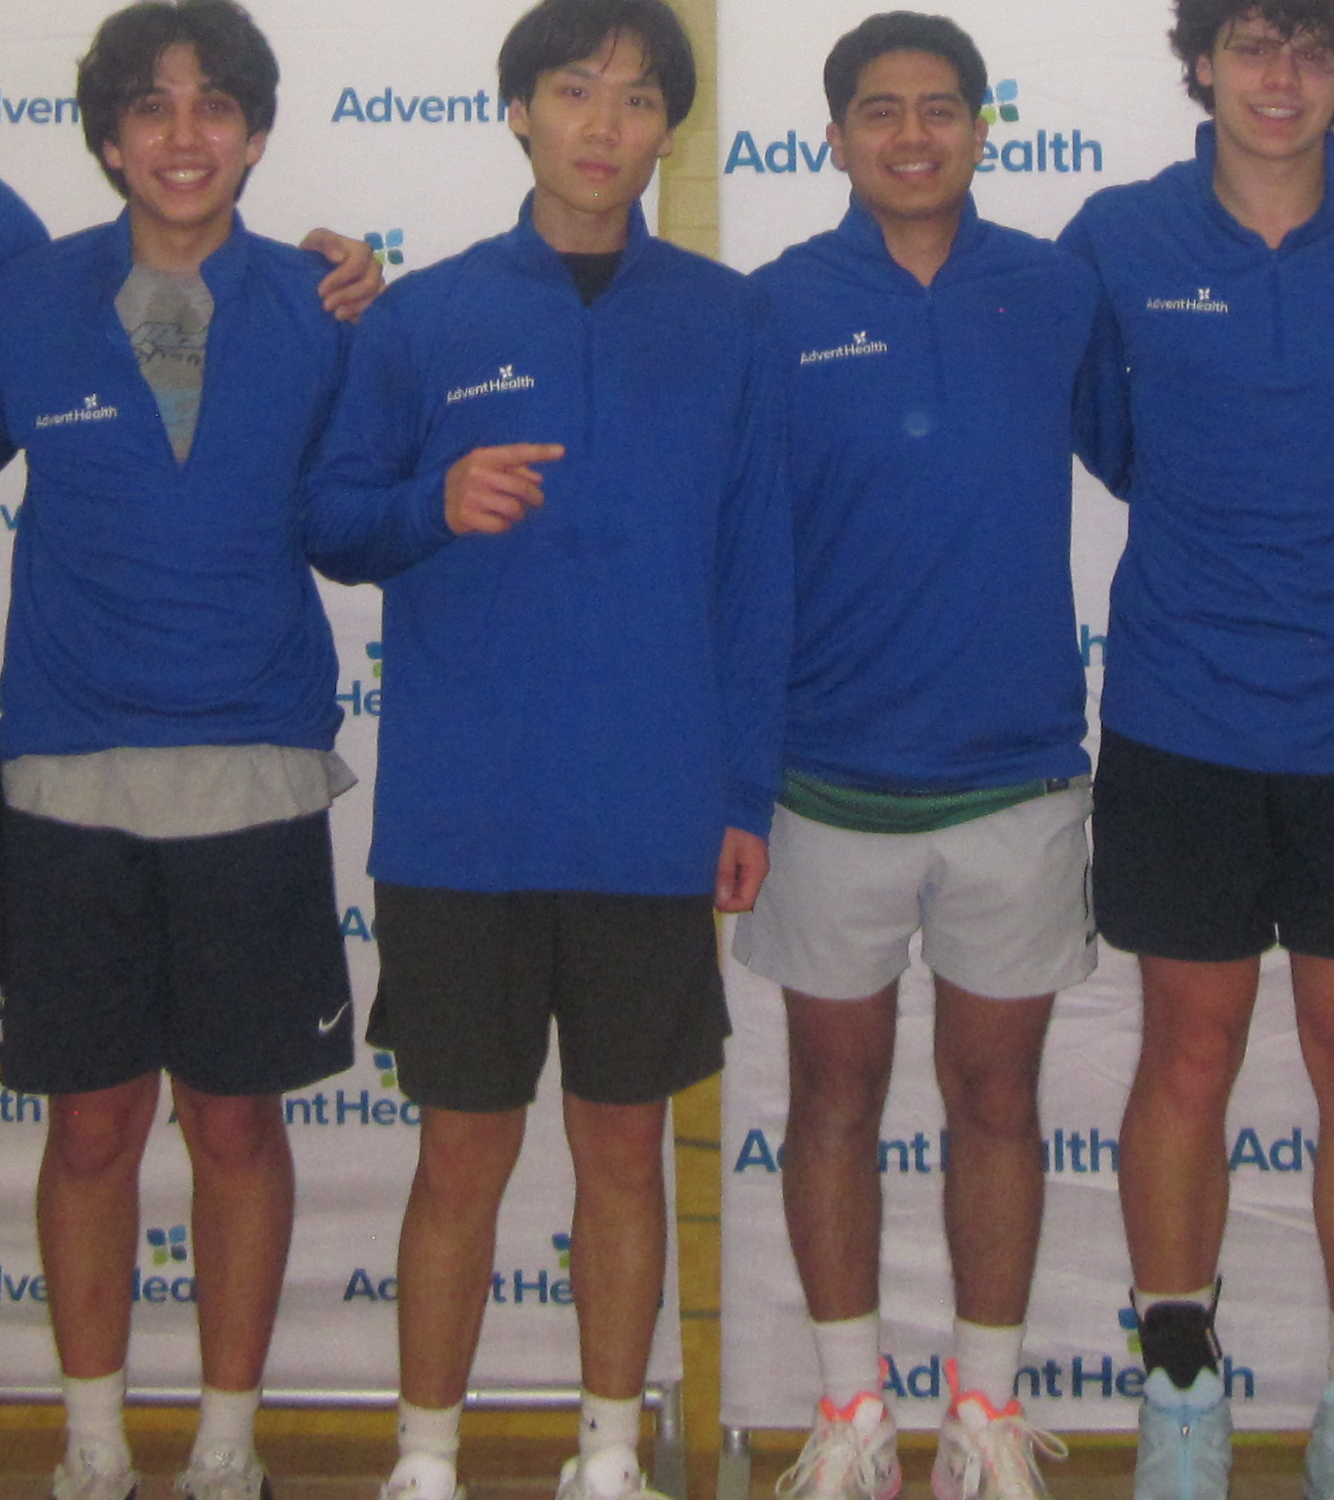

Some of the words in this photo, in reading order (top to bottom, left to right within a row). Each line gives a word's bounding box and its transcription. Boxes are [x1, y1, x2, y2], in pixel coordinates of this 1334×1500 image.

[330, 86, 510, 123] Advent
[1146, 297, 1229, 313] AdventHealth
[800, 341, 889, 365] AdventHealth
[446, 375, 535, 404] AdventHealth
